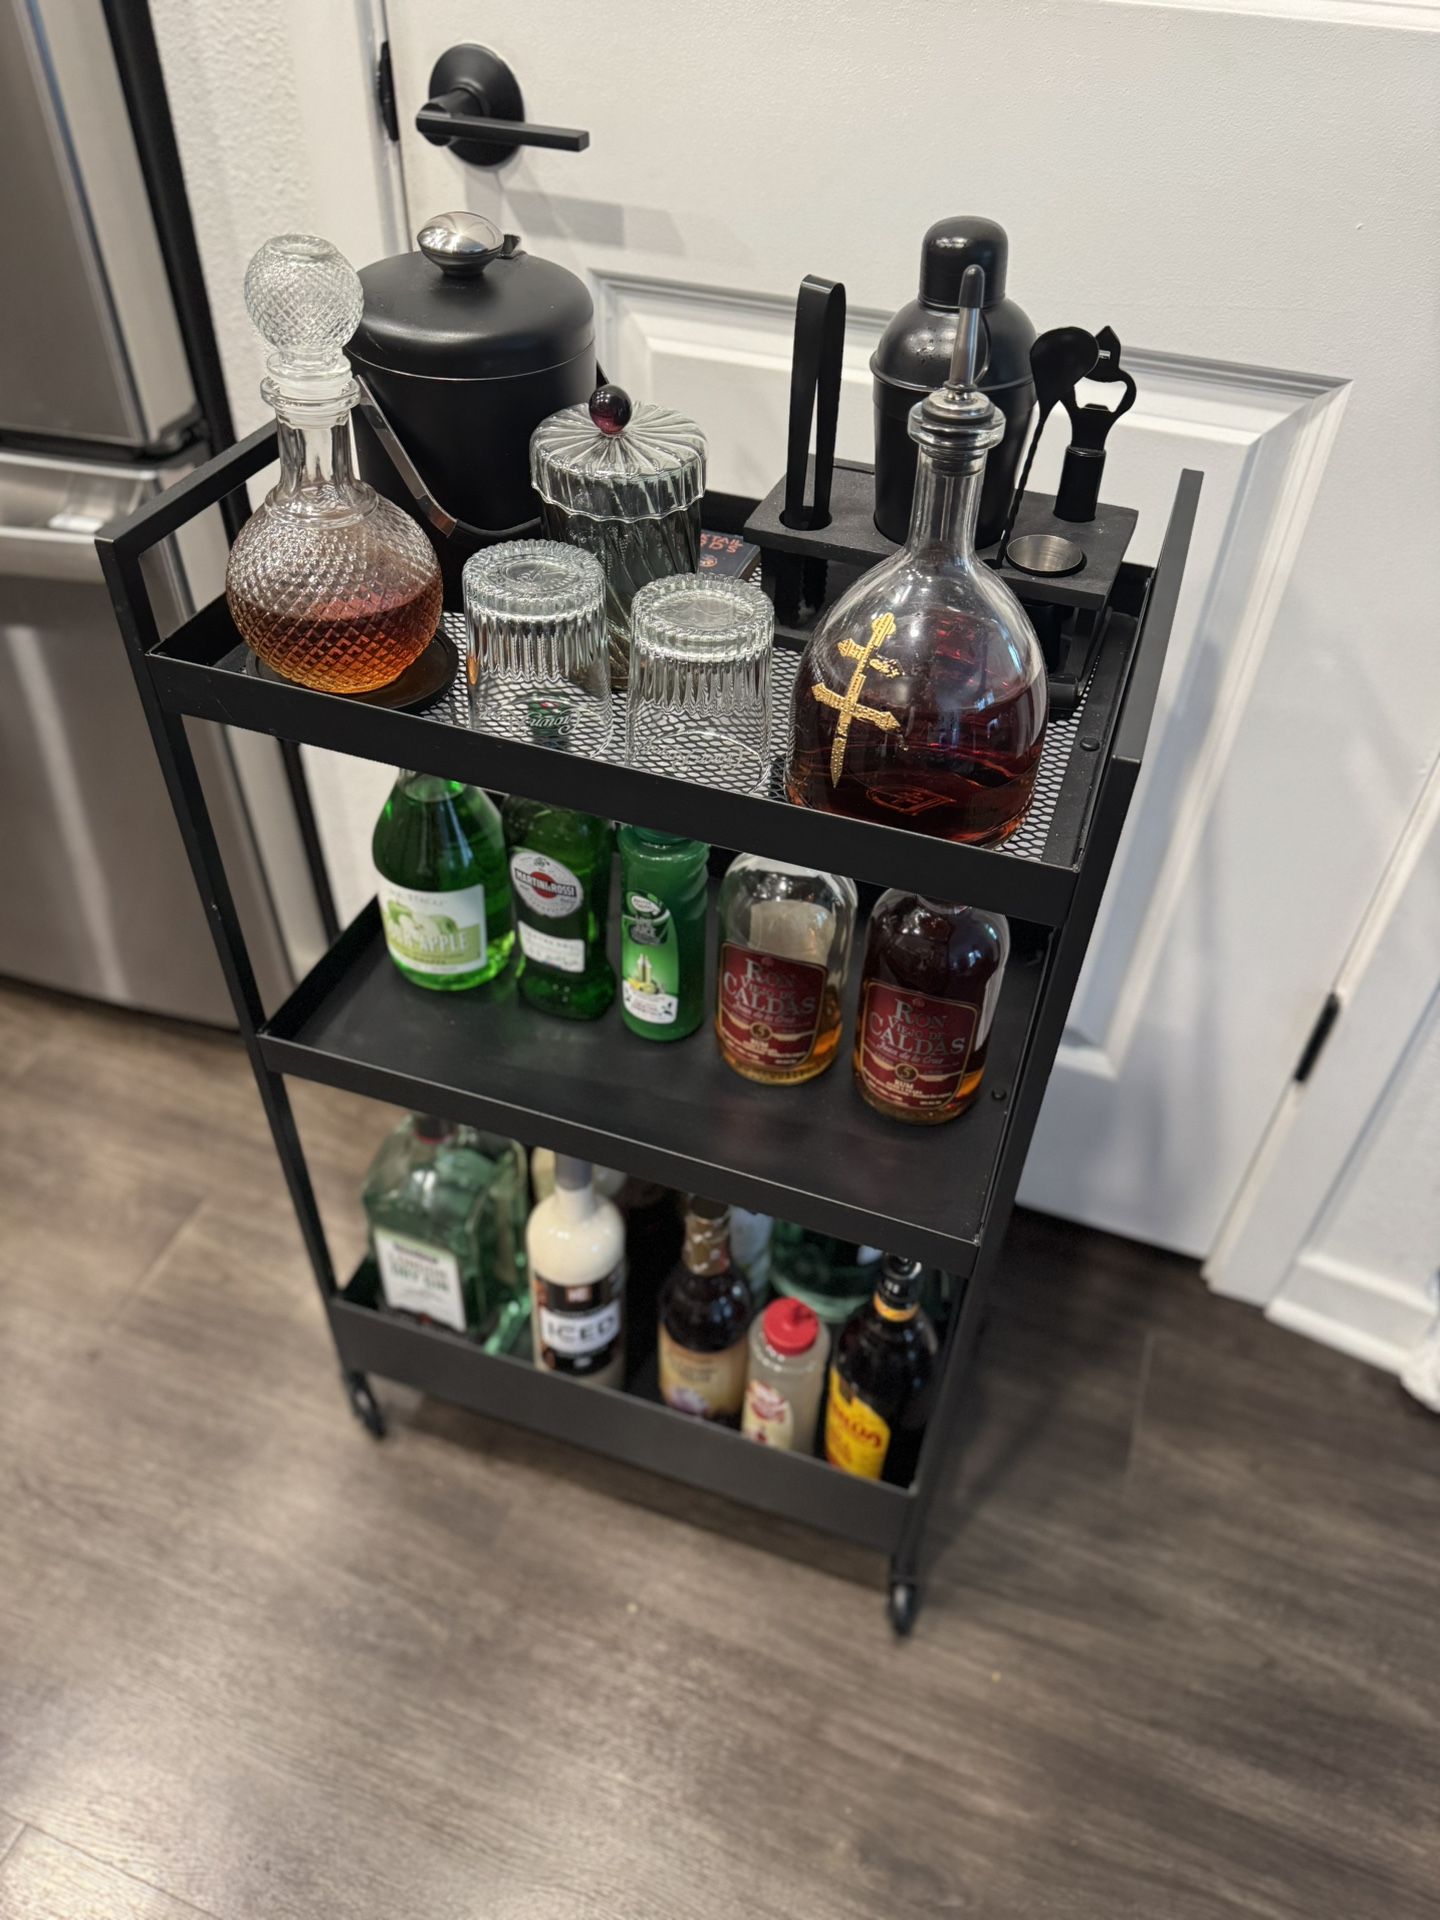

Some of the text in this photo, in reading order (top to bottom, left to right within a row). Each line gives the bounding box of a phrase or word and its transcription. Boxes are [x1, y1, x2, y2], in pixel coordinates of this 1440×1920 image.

[515, 869, 548, 891] MARTINI
[551, 883, 576, 897] ROSSI
[745, 957, 797, 988] RON
[724, 971, 817, 1015] CALDAS
[888, 1014, 945, 1041] VIEJO DE
[895, 998, 948, 1029] RON
[869, 1012, 967, 1057] CALDAS
[547, 1315, 616, 1344] ICED
